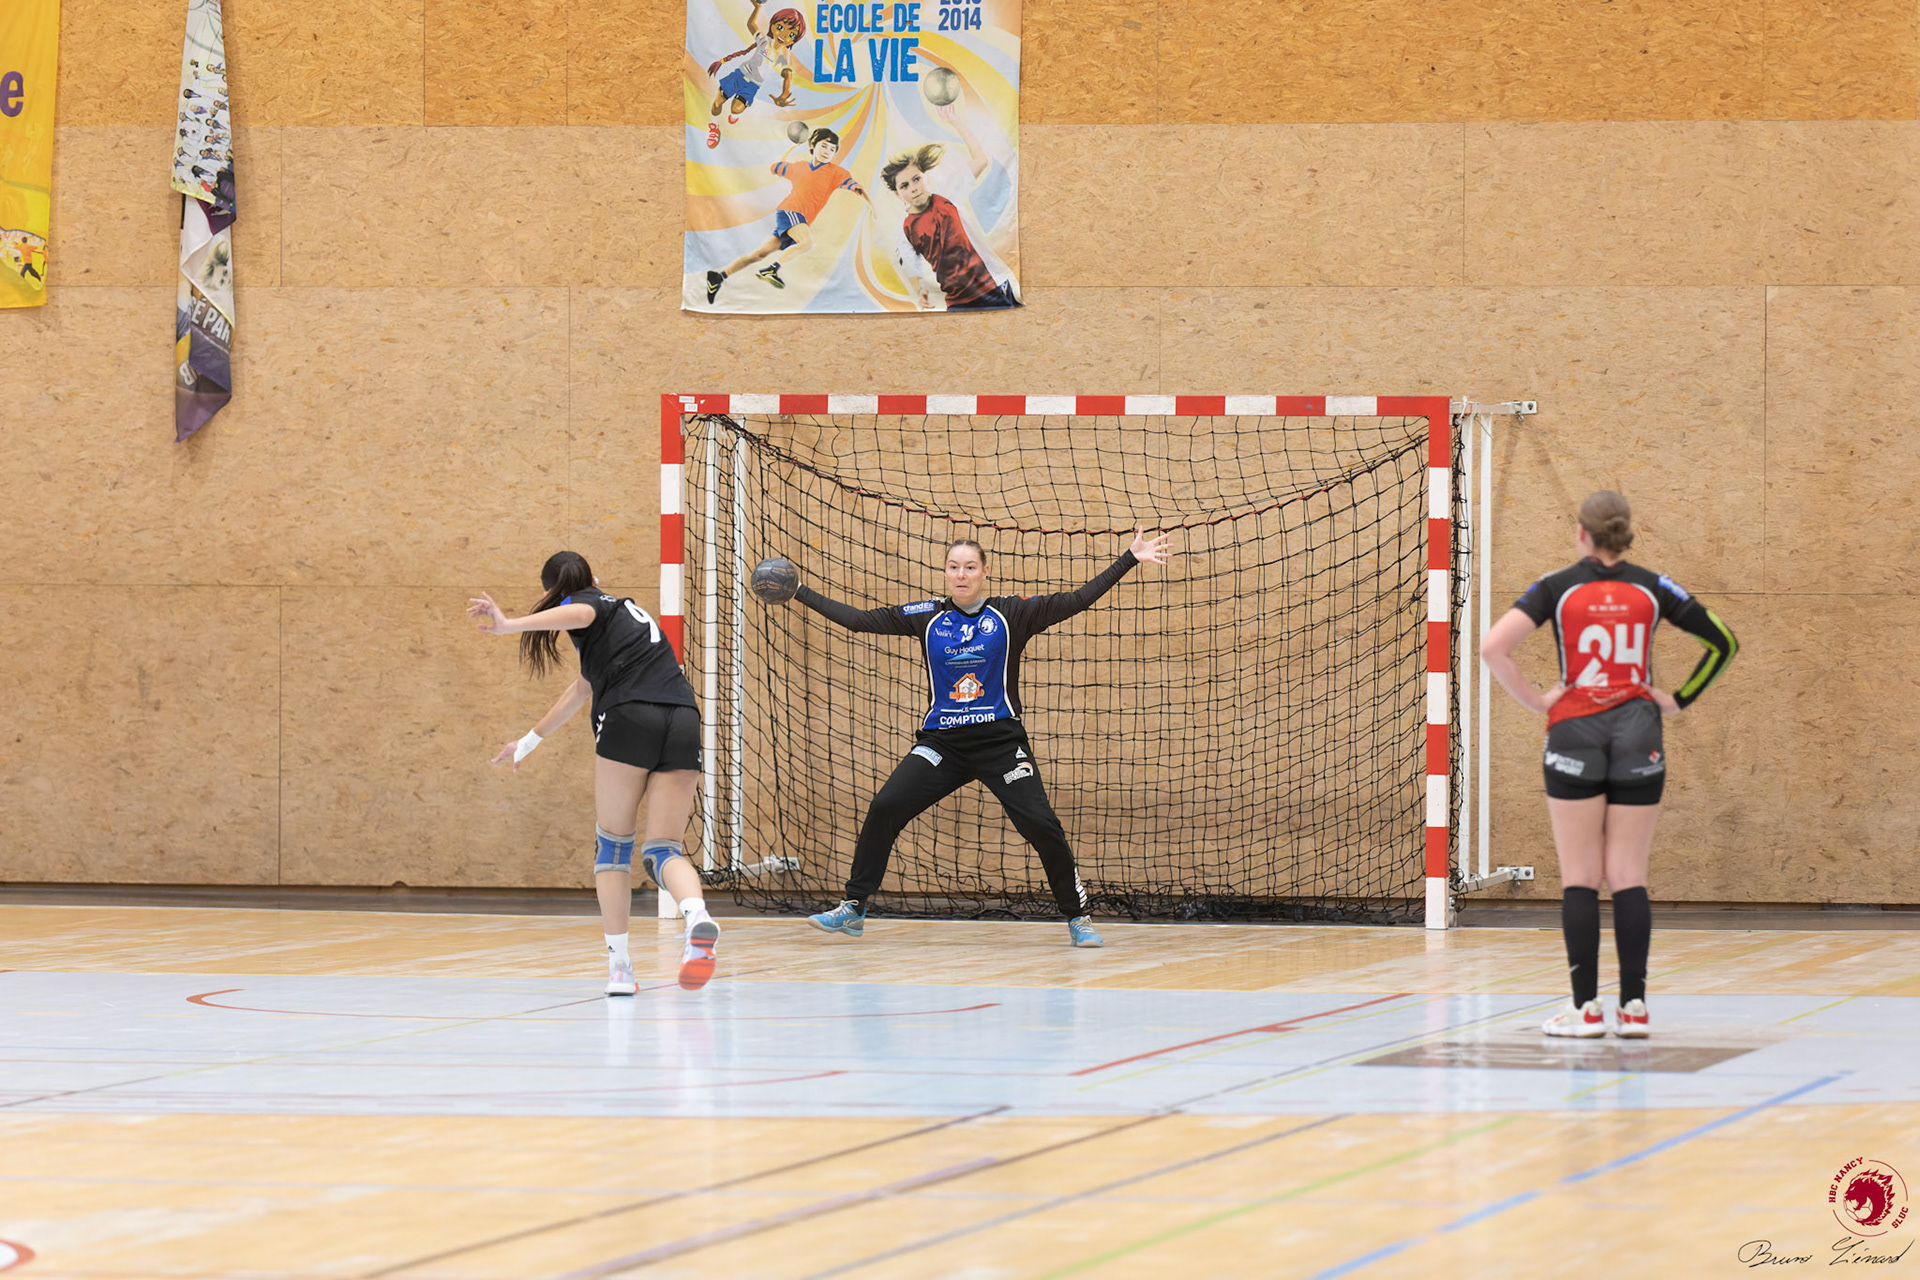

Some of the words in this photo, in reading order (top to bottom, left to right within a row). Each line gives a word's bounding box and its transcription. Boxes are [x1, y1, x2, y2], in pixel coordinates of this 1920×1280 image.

[893, 3, 921, 33] DE
[938, 7, 982, 31] 2014
[813, 38, 856, 83] LA
[868, 38, 919, 82] VIE
[623, 599, 661, 643] 9
[944, 646, 958, 655] Guy
[959, 643, 985, 653] Hoquet
[1576, 623, 1645, 687] 24
[940, 713, 995, 725] COMPTOIR
